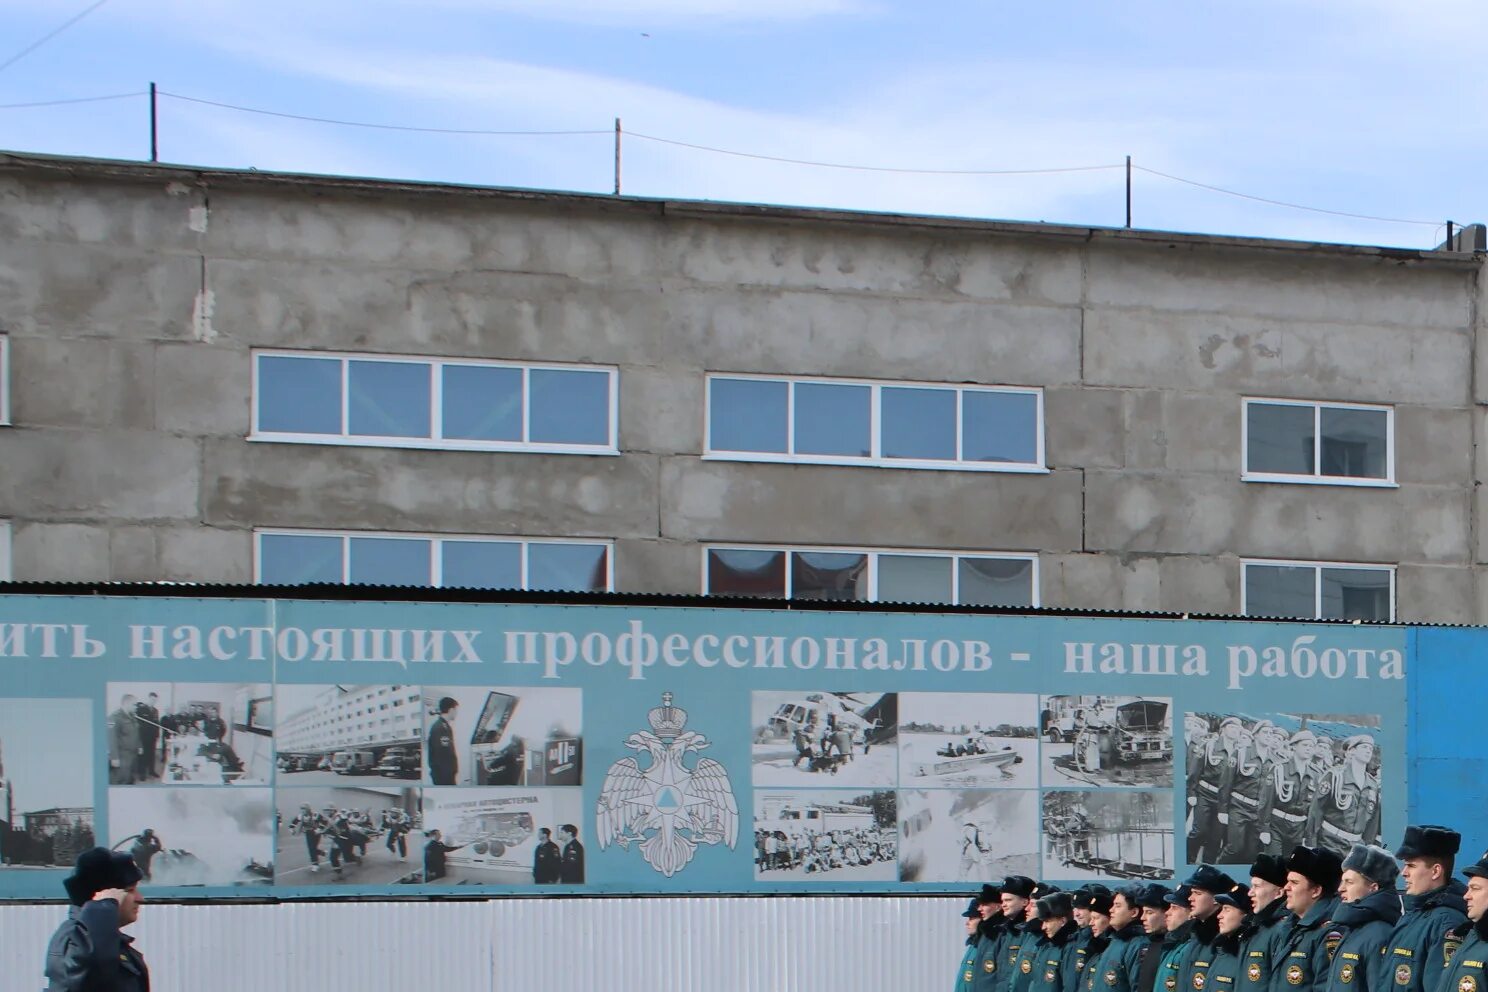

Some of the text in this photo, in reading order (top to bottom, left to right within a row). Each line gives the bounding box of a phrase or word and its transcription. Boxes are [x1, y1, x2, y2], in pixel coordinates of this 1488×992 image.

[127, 625, 484, 670] настоящих
[502, 620, 993, 680] профессионалов
[1010, 652, 1031, 662] -
[1063, 642, 1210, 677] наша
[1225, 635, 1407, 690] работа
